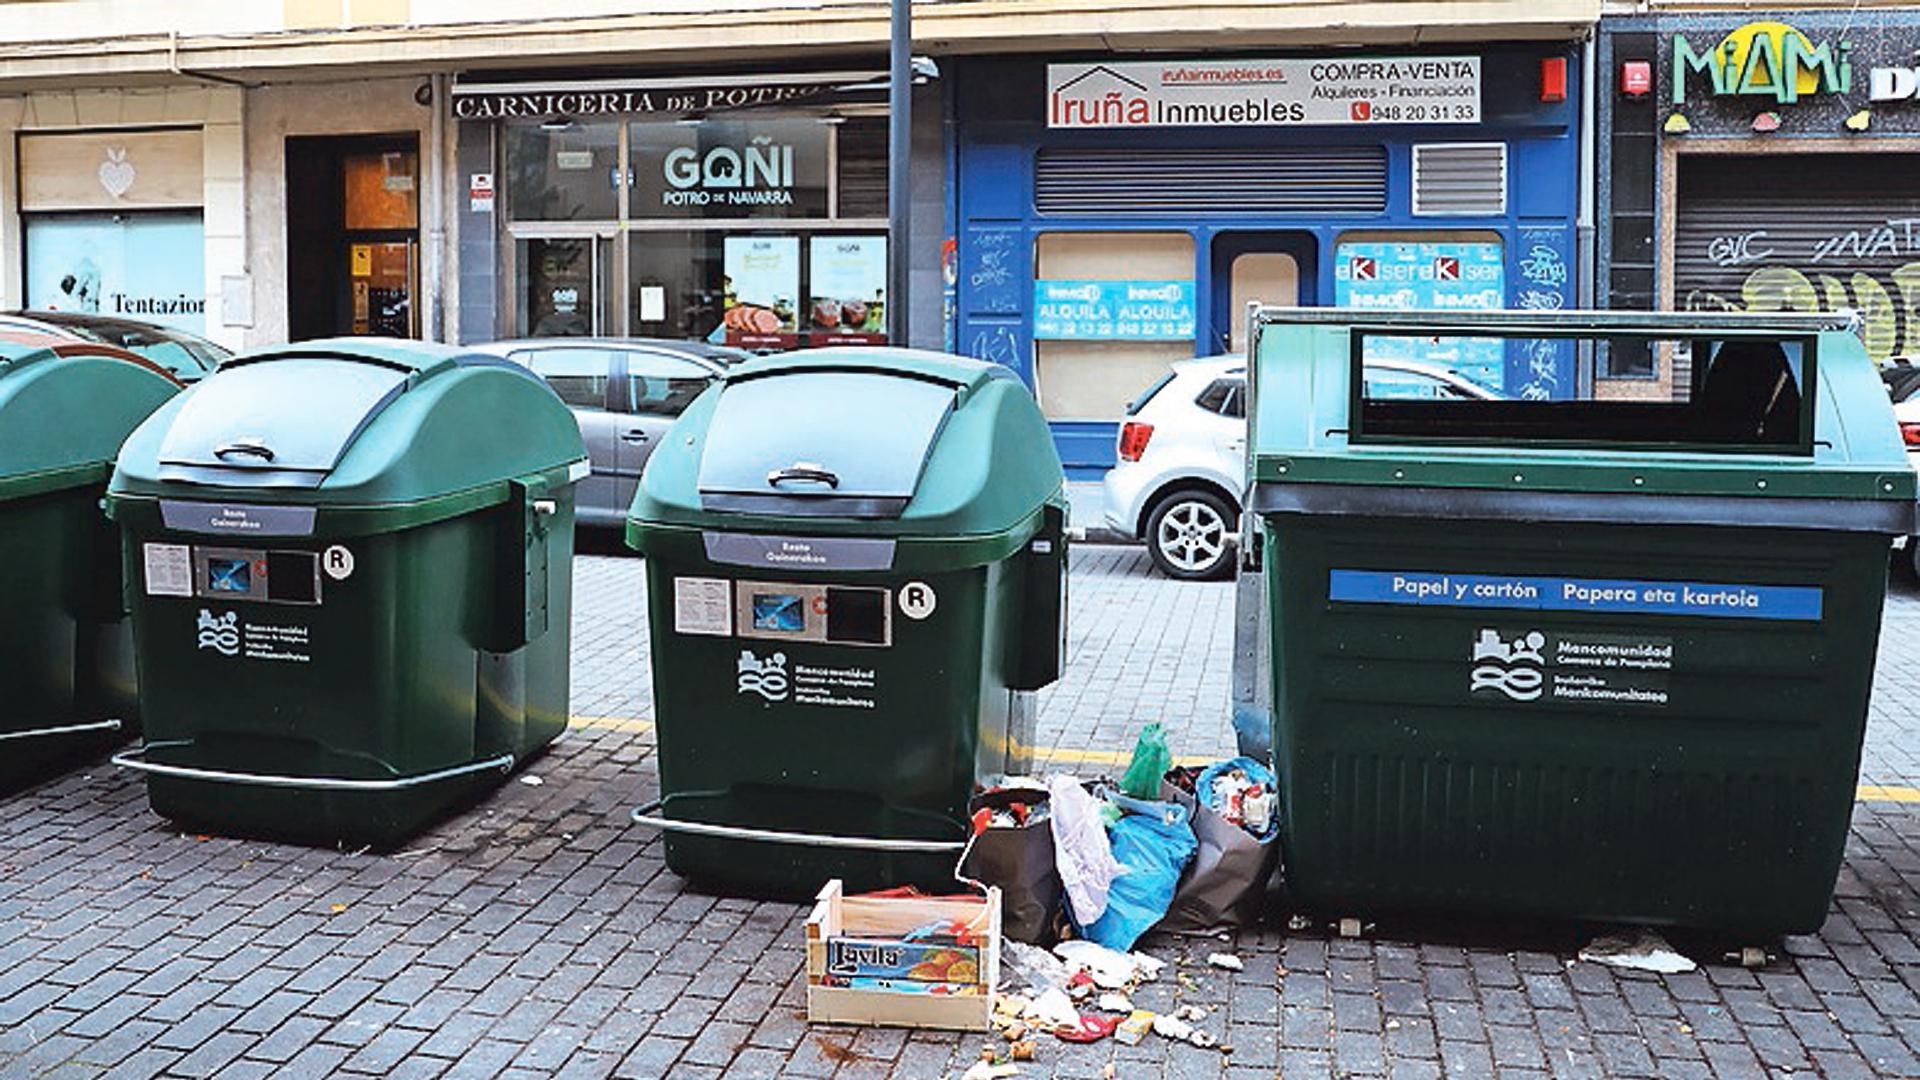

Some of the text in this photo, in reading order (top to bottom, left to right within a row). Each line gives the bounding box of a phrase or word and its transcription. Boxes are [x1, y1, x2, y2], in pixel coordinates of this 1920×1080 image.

[1870, 50, 1920, 100] D
[456, 92, 655, 118] CARNICERIA
[666, 96, 696, 111] DE
[1052, 92, 1306, 124] Iruña Inmuebles
[1371, 104, 1475, 121] 948 20 31 33
[664, 135, 794, 189] GOÑI
[663, 191, 710, 206] POTRO
[727, 191, 793, 205] NAVARRA
[1040, 303, 1191, 321] ALQUILA ALQUILA
[331, 551, 345, 569] R
[907, 588, 925, 607] R
[1393, 577, 1536, 599] Papel y cartón
[1563, 583, 1759, 607] Papera eta kartoia
[1558, 641, 1673, 657] Mancomunidad
